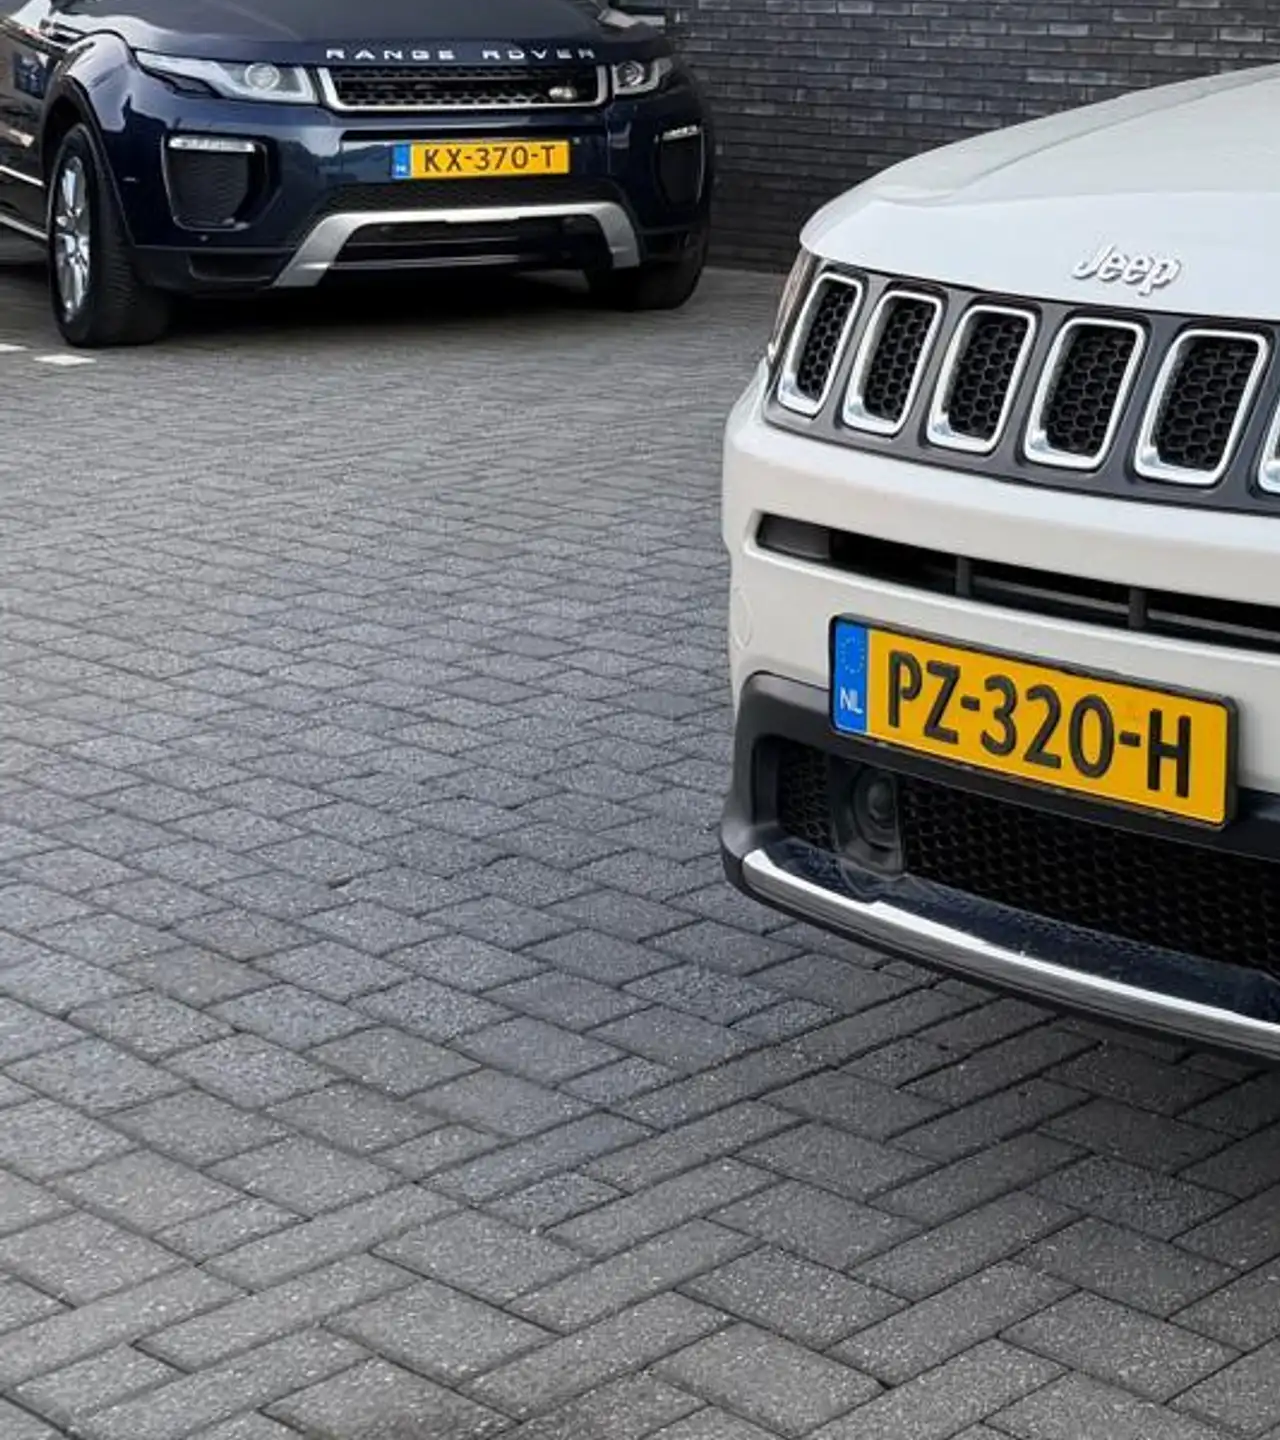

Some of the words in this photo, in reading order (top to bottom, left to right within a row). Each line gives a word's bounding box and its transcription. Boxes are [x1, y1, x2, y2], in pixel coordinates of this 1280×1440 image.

[326, 48, 455, 60] RANGE
[481, 47, 596, 60] ROVER
[424, 144, 556, 173] KX-370-T
[1072, 243, 1181, 297] Jeep
[839, 686, 864, 715] NL
[888, 649, 1192, 798] PZ-320-H
